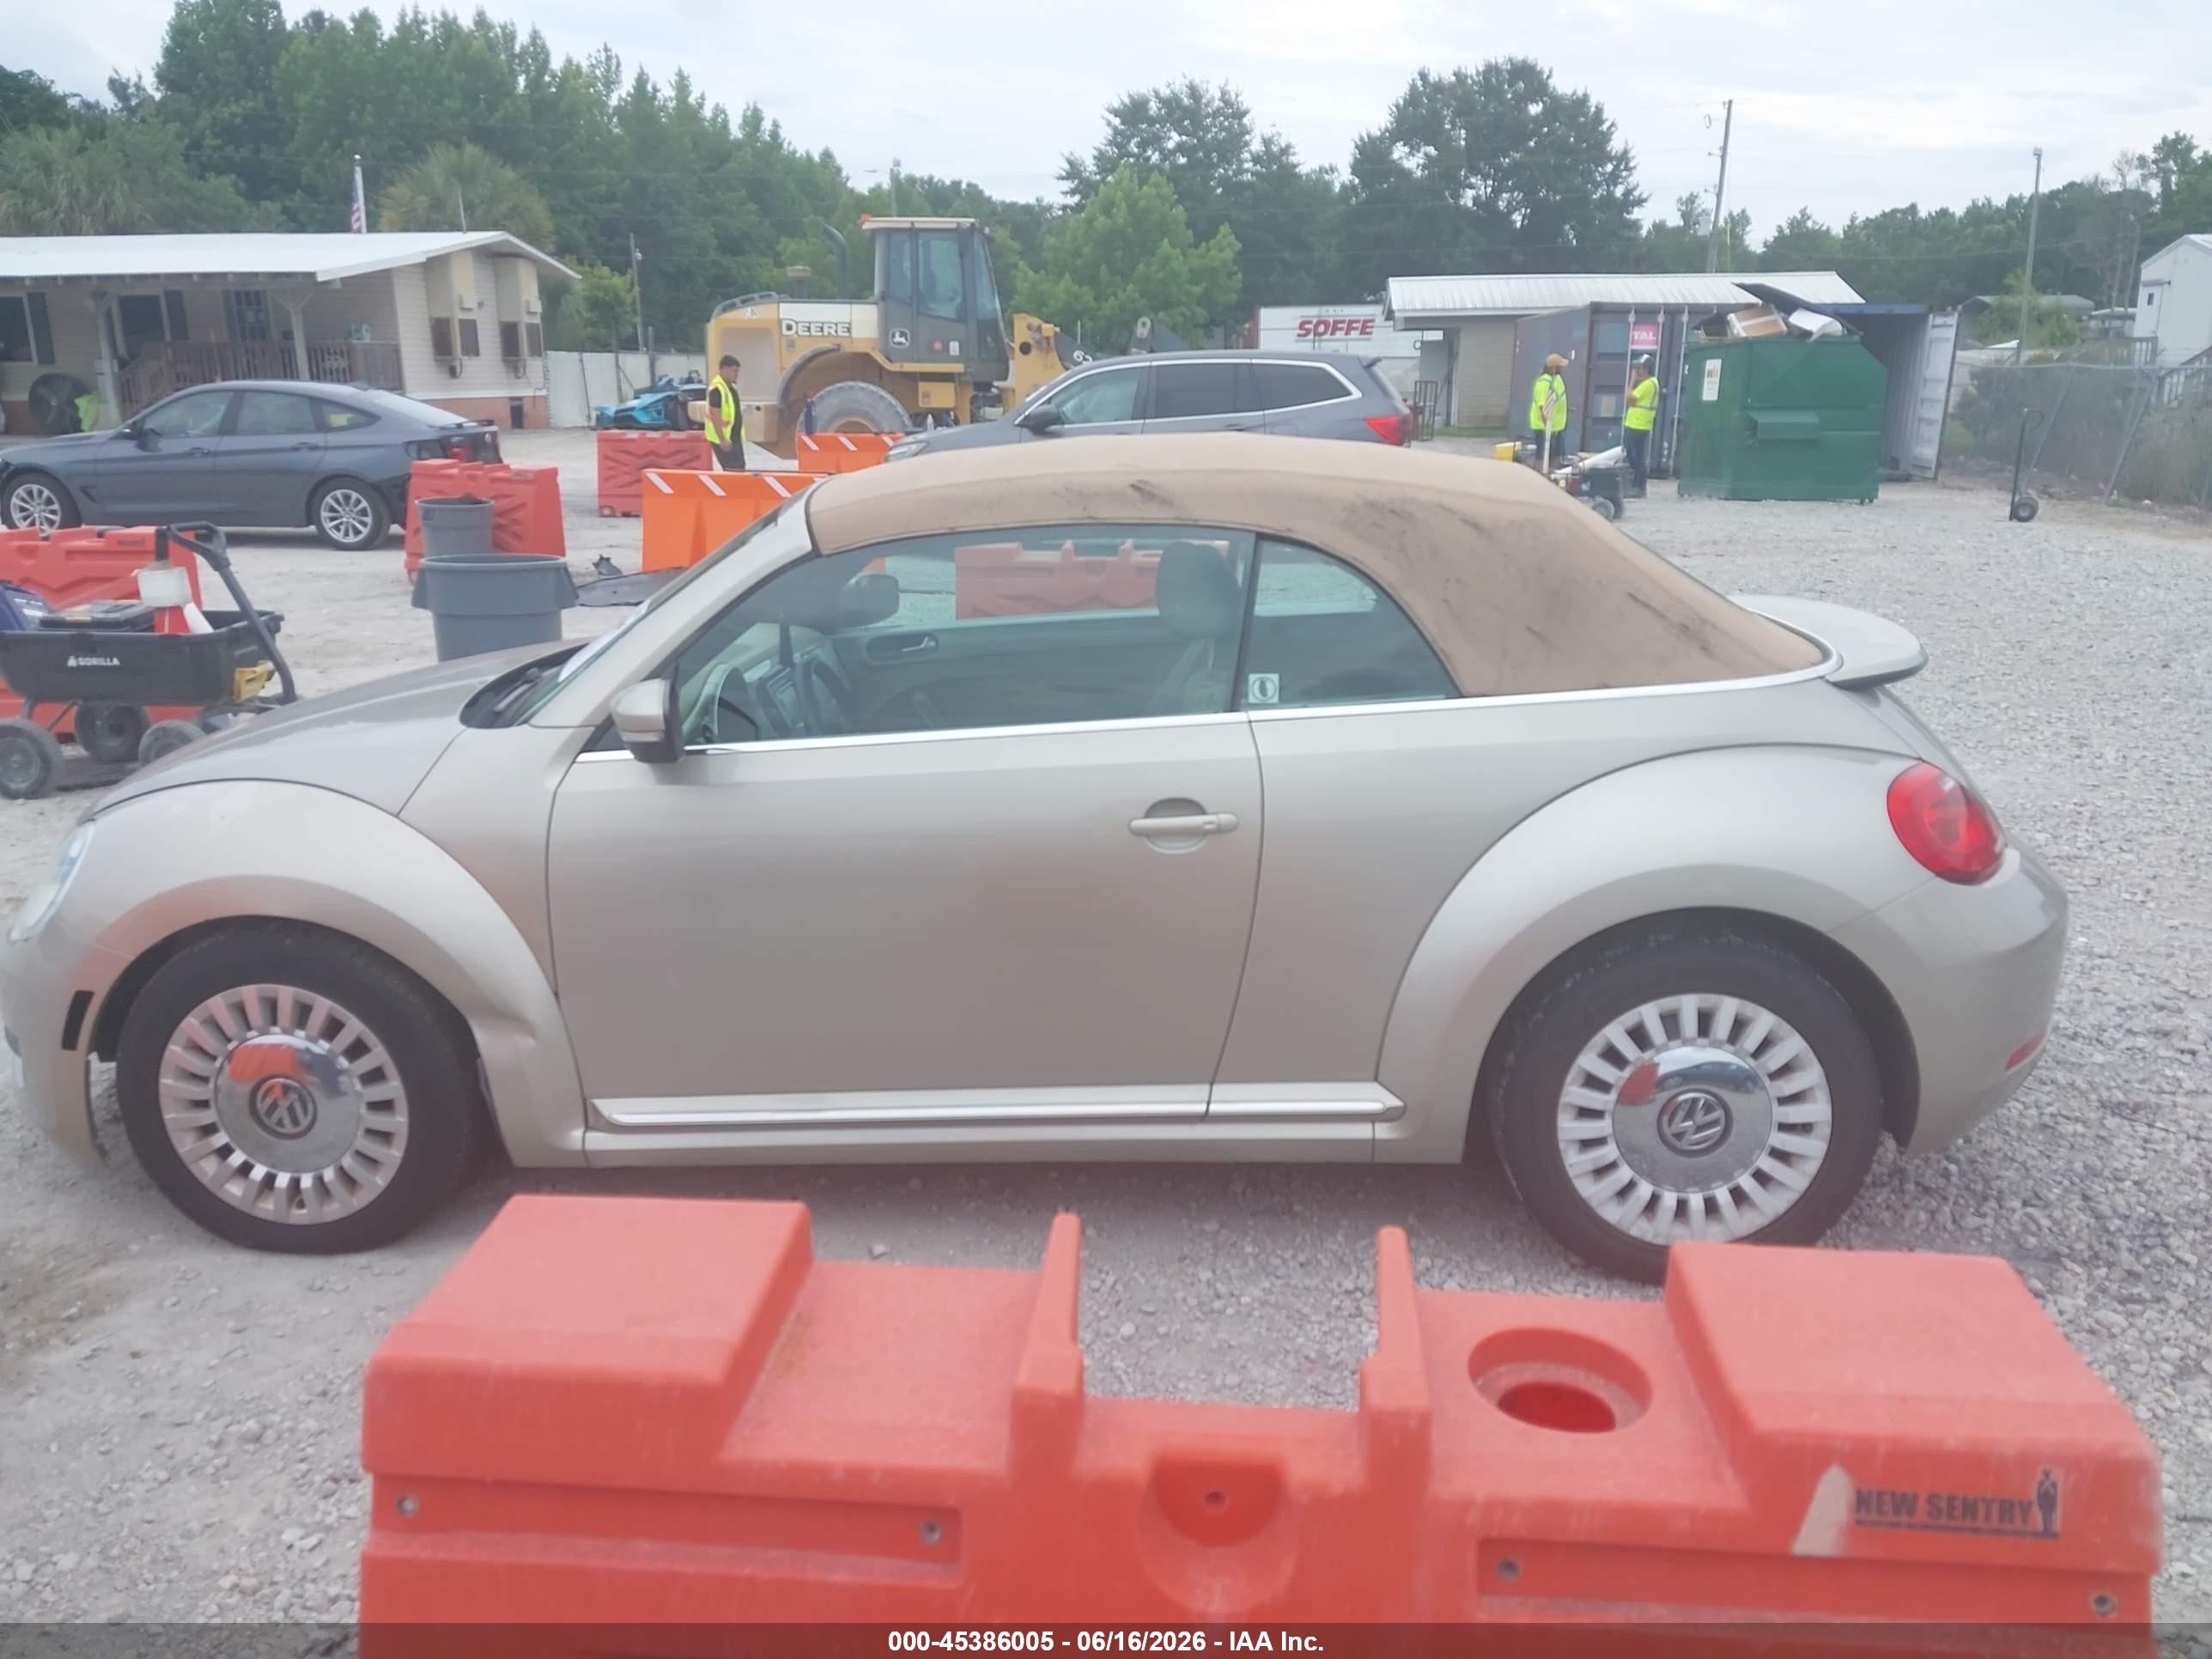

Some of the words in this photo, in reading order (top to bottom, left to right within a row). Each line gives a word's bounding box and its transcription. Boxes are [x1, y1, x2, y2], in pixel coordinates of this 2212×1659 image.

[782, 319, 851, 336] DEERE
[1296, 318, 1376, 337] SOFFE
[1633, 331, 1656, 340] TAL
[77, 657, 120, 666] GORILLA
[1855, 1488, 1919, 1516] NEW
[1926, 1492, 2035, 1526] SENTRY
